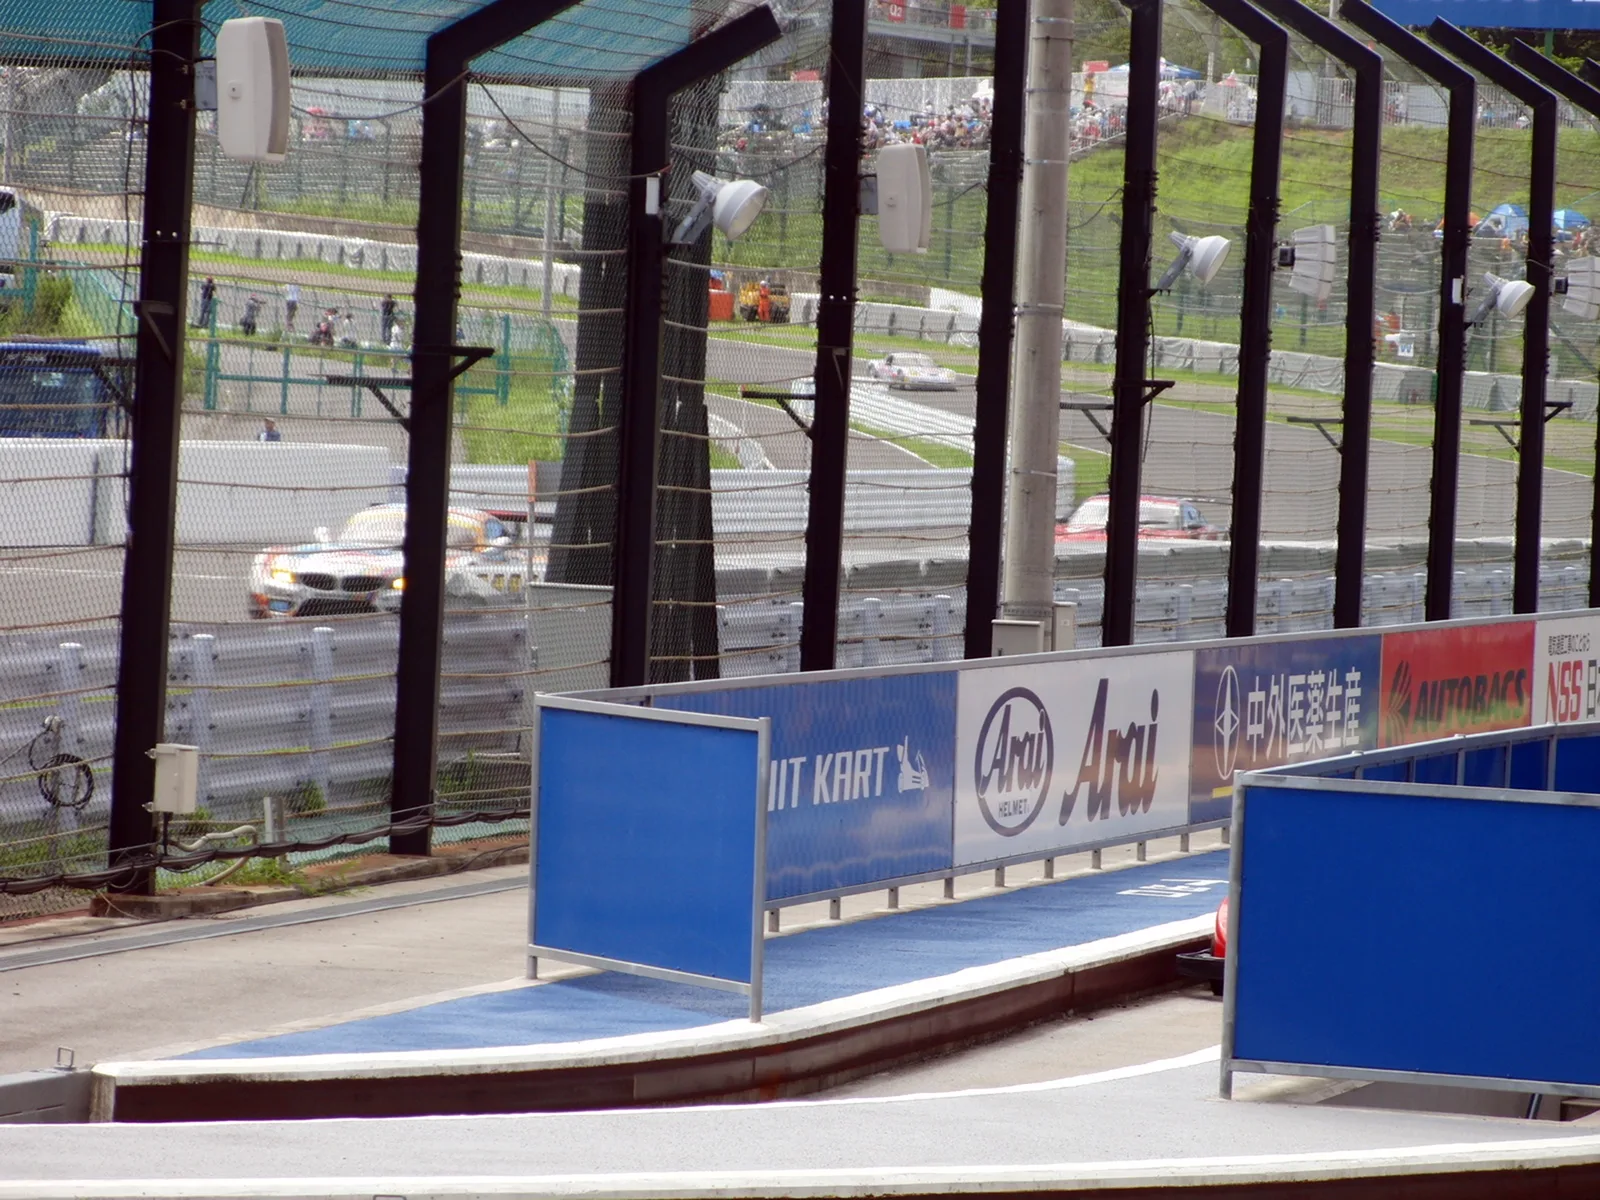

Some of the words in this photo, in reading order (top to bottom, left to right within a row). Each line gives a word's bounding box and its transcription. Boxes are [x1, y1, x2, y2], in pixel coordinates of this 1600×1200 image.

[1246, 666, 1361, 762] 中外医薬生産
[1411, 668, 1526, 734] AUTOBACS
[1545, 660, 1583, 723] NSS
[1587, 659, 1600, 719] 日
[813, 746, 890, 806] KART
[979, 704, 1045, 796] Arai
[1058, 678, 1159, 827] Arai
[999, 798, 1028, 818] HELMET
